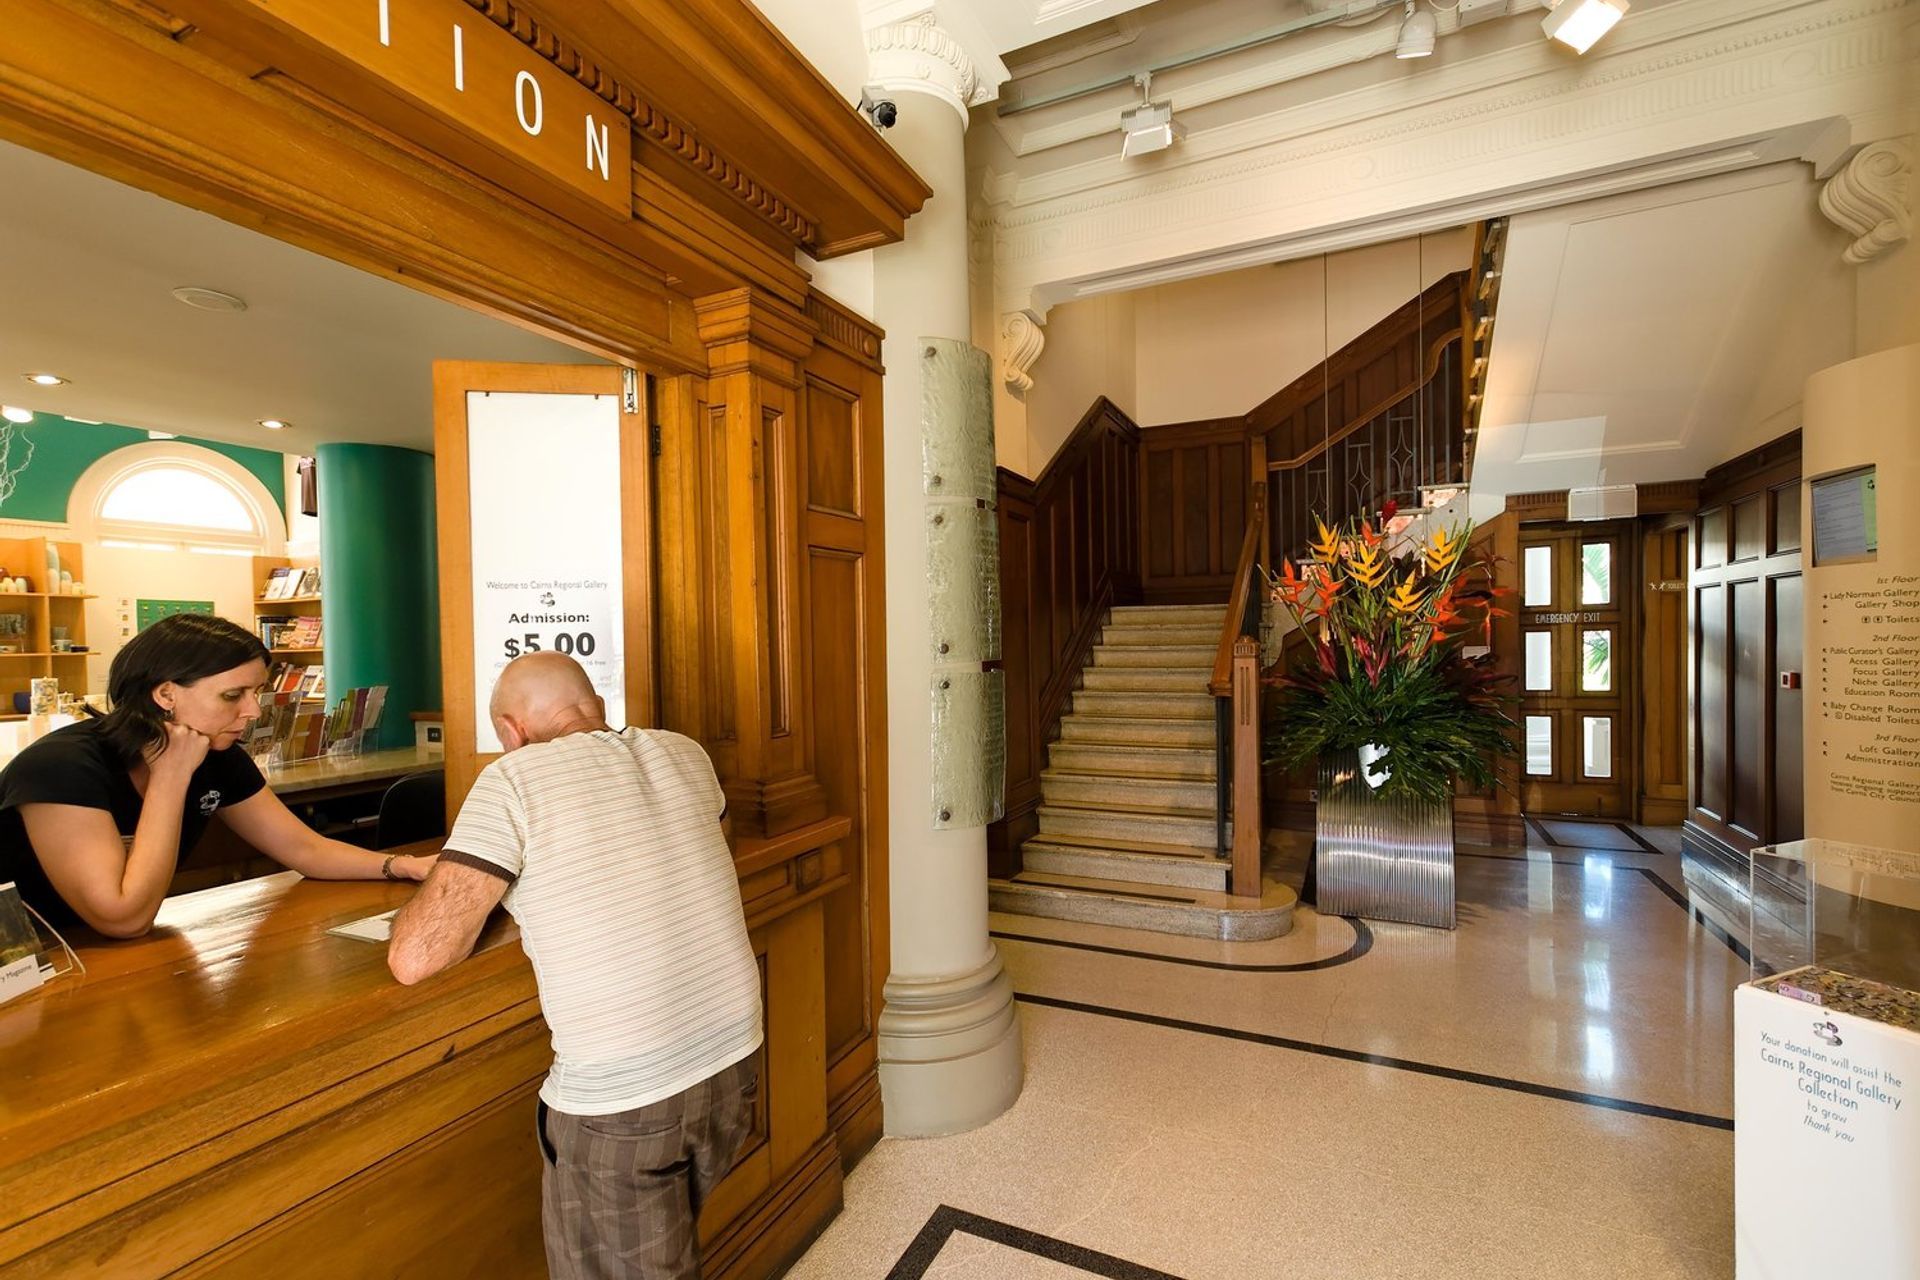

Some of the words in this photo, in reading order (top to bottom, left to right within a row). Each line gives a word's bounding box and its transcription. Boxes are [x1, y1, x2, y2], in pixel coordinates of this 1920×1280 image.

[486, 582, 519, 590] Welcome
[530, 580, 553, 590] Cairns
[554, 580, 583, 590] Regional
[584, 580, 609, 590] Gallery
[1846, 590, 1881, 598] Norman
[1882, 588, 1920, 598] Gallery
[1854, 600, 1888, 608] Gallery
[1892, 600, 1920, 608] Shop
[508, 612, 591, 624] Admission:
[1536, 612, 1580, 624] EMERGENCY
[1584, 612, 1601, 622] EXIT
[1886, 614, 1920, 624] Toilets
[1892, 634, 1920, 642] Floor
[504, 632, 596, 660] $500
[1886, 646, 1920, 656] Gallery
[1882, 658, 1920, 666] Gallery
[1882, 668, 1920, 678] Gallery
[1882, 678, 1920, 688] Gallery
[1844, 686, 1886, 696] Education
[1890, 690, 1920, 698] Room
[1850, 704, 1883, 714] Change
[1888, 704, 1920, 714] Room
[1844, 712, 1881, 722] Disabled
[1886, 714, 1920, 724] Toilets
[1892, 734, 1920, 742] Floor
[1881, 746, 1920, 759] Gallery
[1845, 752, 1920, 768] Administration
[1888, 780, 1920, 790] Gallery
[1760, 1030, 1781, 1047] Your
[1784, 1040, 1828, 1063] donation
[1830, 1057, 1850, 1070] will
[1852, 1065, 1879, 1080] assist
[1883, 1071, 1903, 1088] the
[1760, 1047, 1795, 1071] Cairns
[1798, 1060, 1852, 1091] Regional
[1855, 1080, 1903, 1111] Gallery
[1797, 1077, 1859, 1111] Collection
[1806, 1098, 1818, 1113] to
[1820, 1107, 1848, 1124] grow
[1834, 1129, 1855, 1144] you
